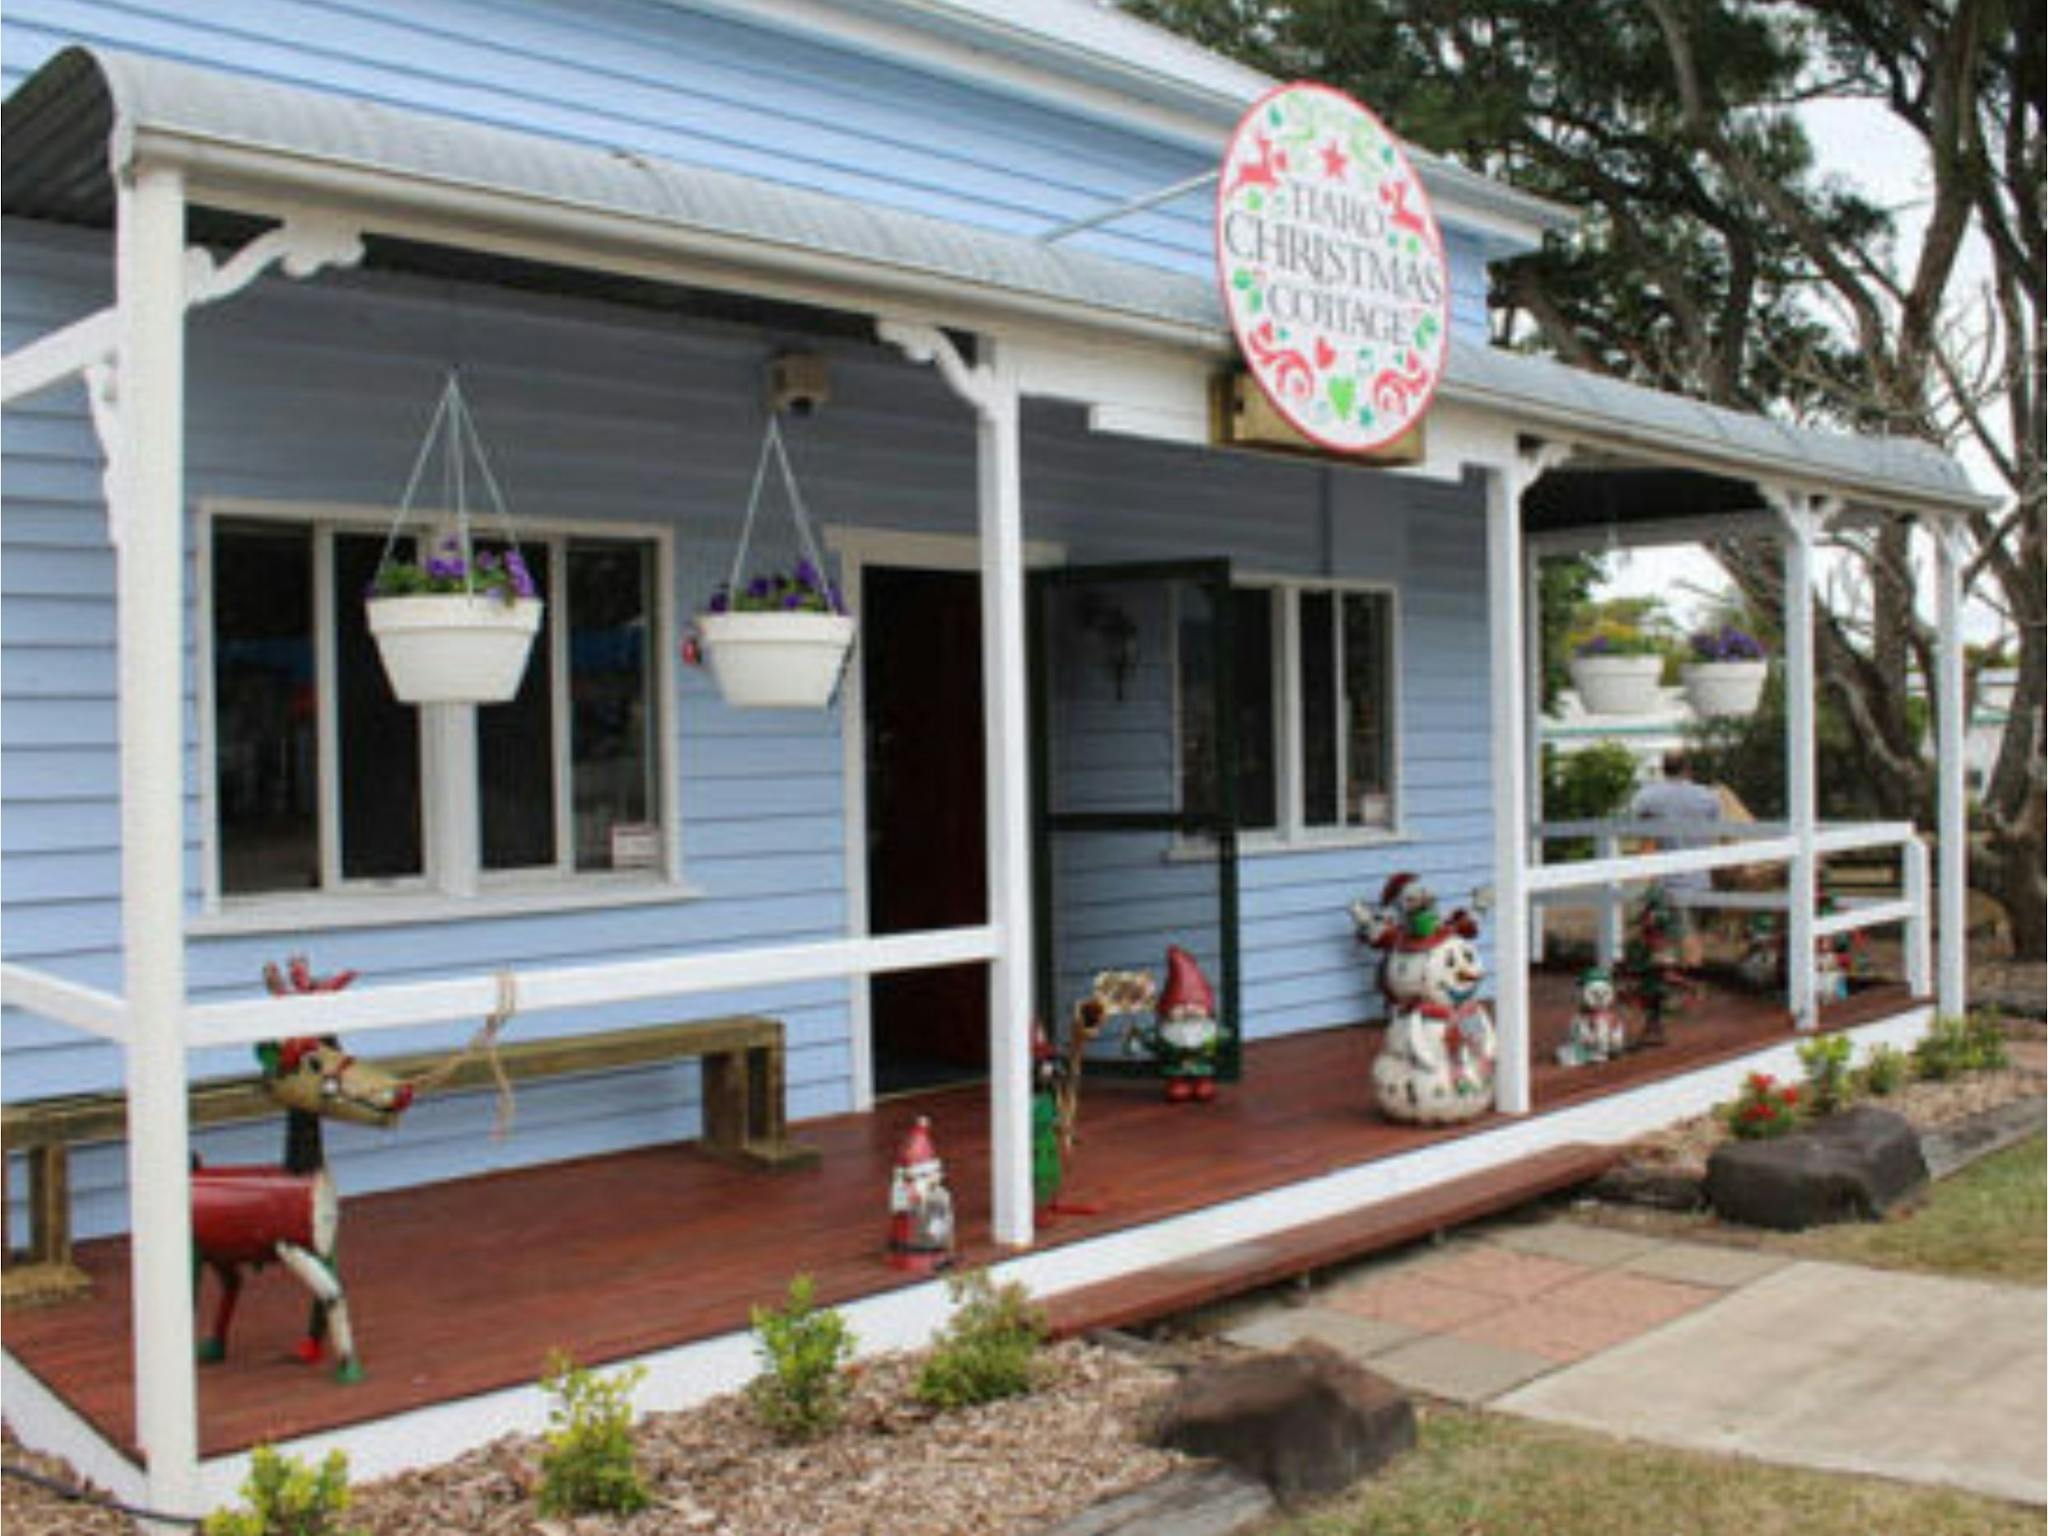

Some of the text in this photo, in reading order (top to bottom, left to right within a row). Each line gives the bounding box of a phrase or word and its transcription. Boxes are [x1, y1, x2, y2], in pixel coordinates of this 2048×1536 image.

[1287, 180, 1386, 241] TIARO
[1225, 211, 1441, 305] CHRISTMAS
[1268, 284, 1410, 346] COTTAGE
